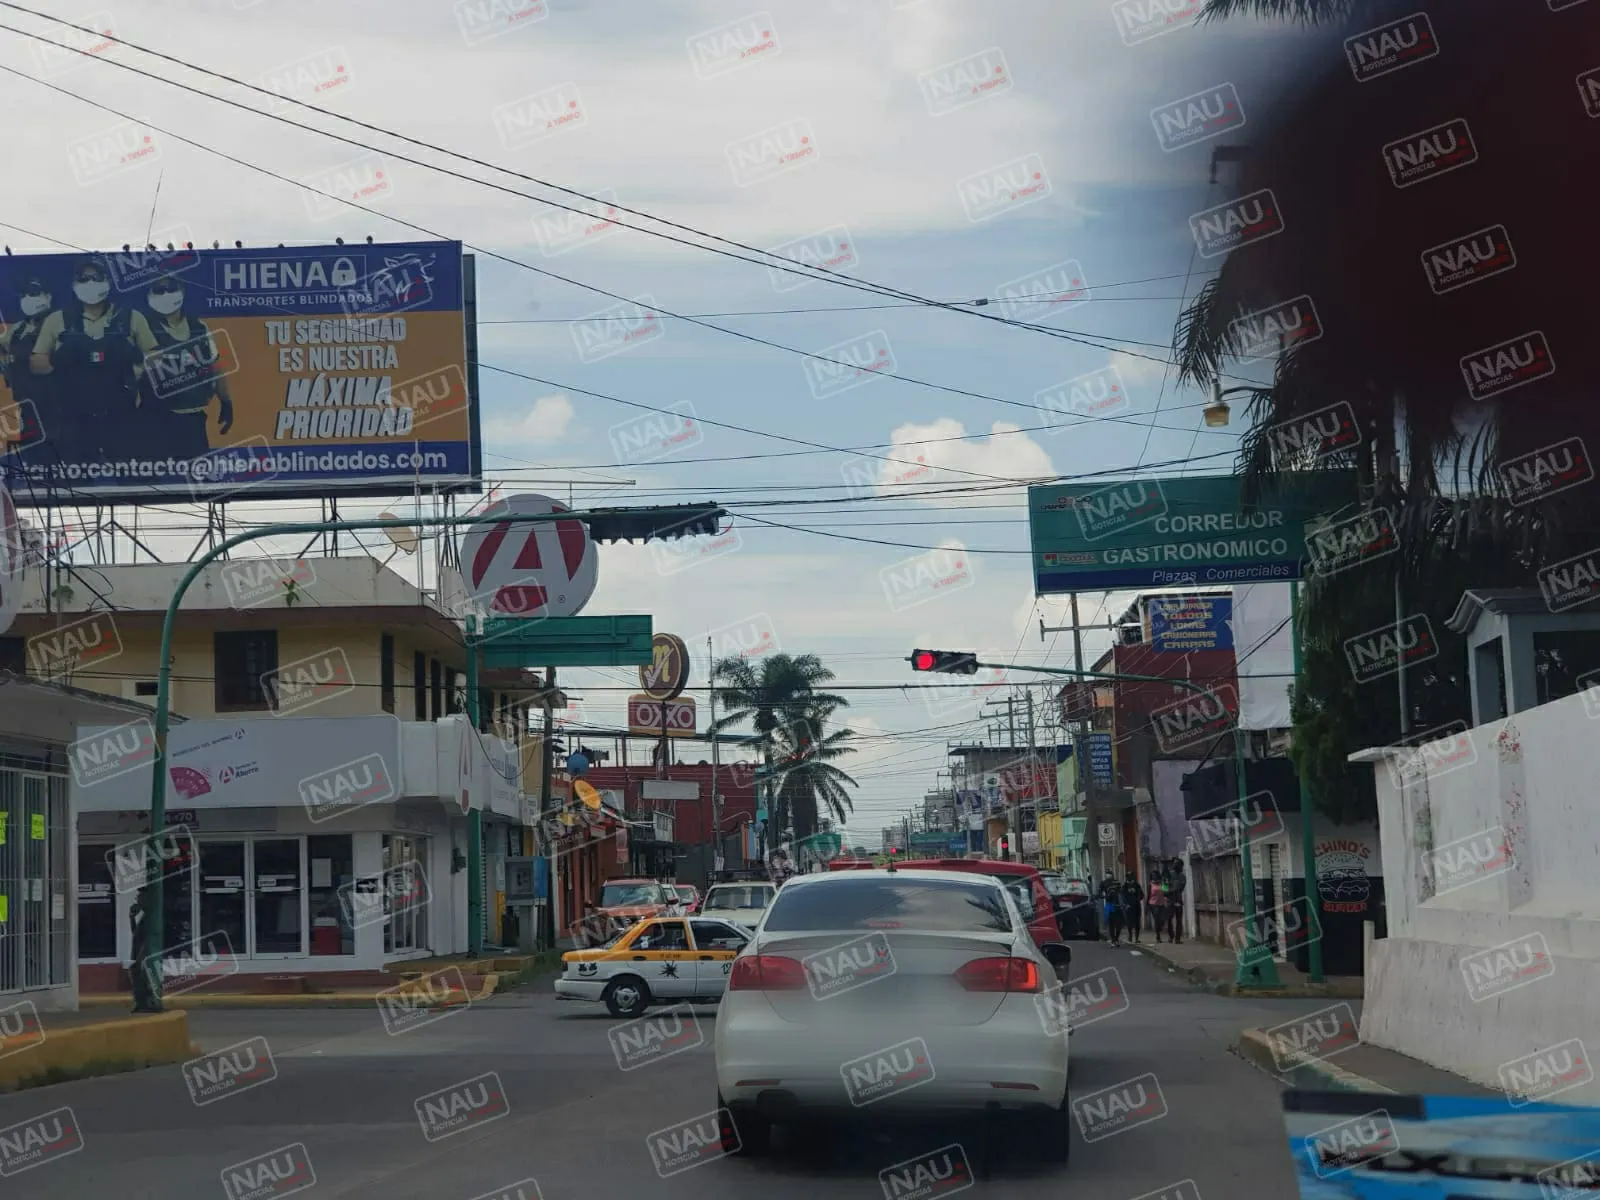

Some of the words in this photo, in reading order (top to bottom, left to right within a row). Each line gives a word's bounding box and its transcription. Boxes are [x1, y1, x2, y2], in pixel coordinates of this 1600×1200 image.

[224, 261, 328, 290] HIENA
[208, 295, 296, 308] TRANSPORTES
[300, 292, 373, 305] BLINDADOS
[265, 320, 290, 345] TU
[295, 317, 407, 344] SEGURIDAD
[279, 347, 304, 372] ES
[309, 345, 399, 371] NUESTRA
[286, 372, 392, 408] MÁXIMA
[275, 406, 414, 440] PRIORIDAD
[1154, 510, 1283, 534] CORREDOR
[1103, 538, 1287, 565] GASTRONOMICO
[1153, 570, 1197, 583] Plazas
[1206, 564, 1289, 581] Comerciales
[636, 703, 694, 728] OXXO
